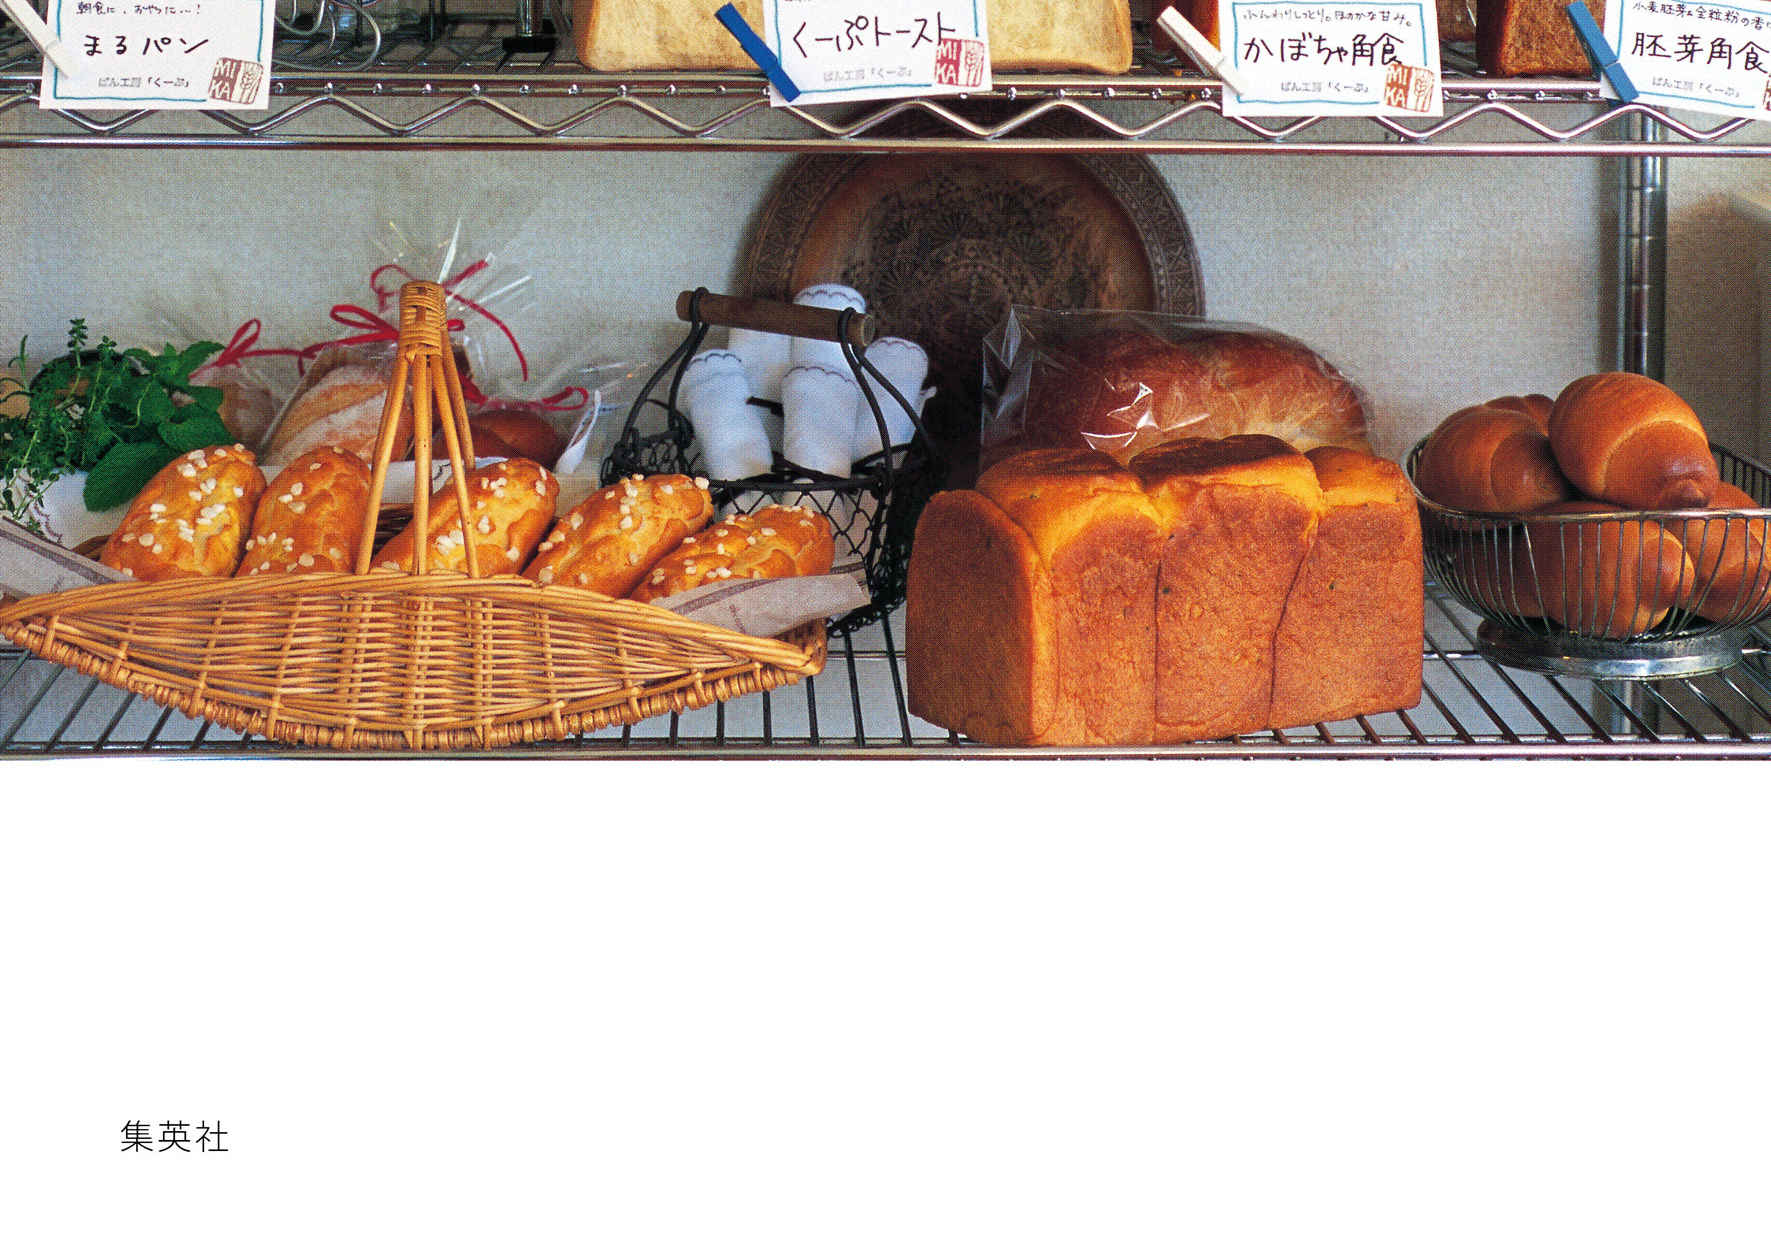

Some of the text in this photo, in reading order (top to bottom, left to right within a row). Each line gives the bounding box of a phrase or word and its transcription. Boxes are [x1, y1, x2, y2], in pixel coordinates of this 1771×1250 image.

[84, 35, 209, 57] まるパン
[792, 11, 956, 58] くーぷトースト
[1243, 31, 1404, 67] かぼちゃ角食
[1631, 32, 1770, 74] 胚芽角食
